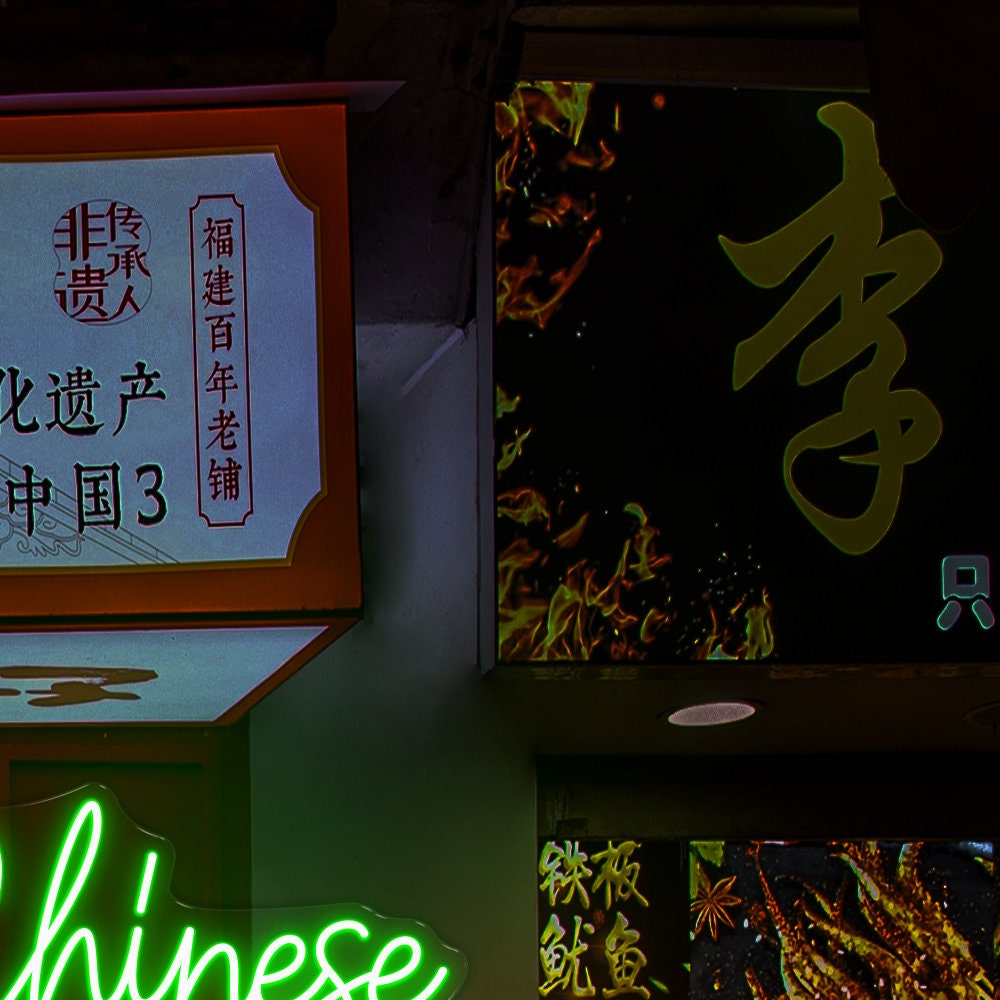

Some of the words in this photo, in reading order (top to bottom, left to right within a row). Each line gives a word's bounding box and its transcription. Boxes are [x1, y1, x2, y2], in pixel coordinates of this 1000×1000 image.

[202, 217, 243, 501] 福建百年老铺
[937, 554, 996, 631] 只
[539, 840, 650, 911] 铁板
[538, 912, 651, 999] 鱿鱼
